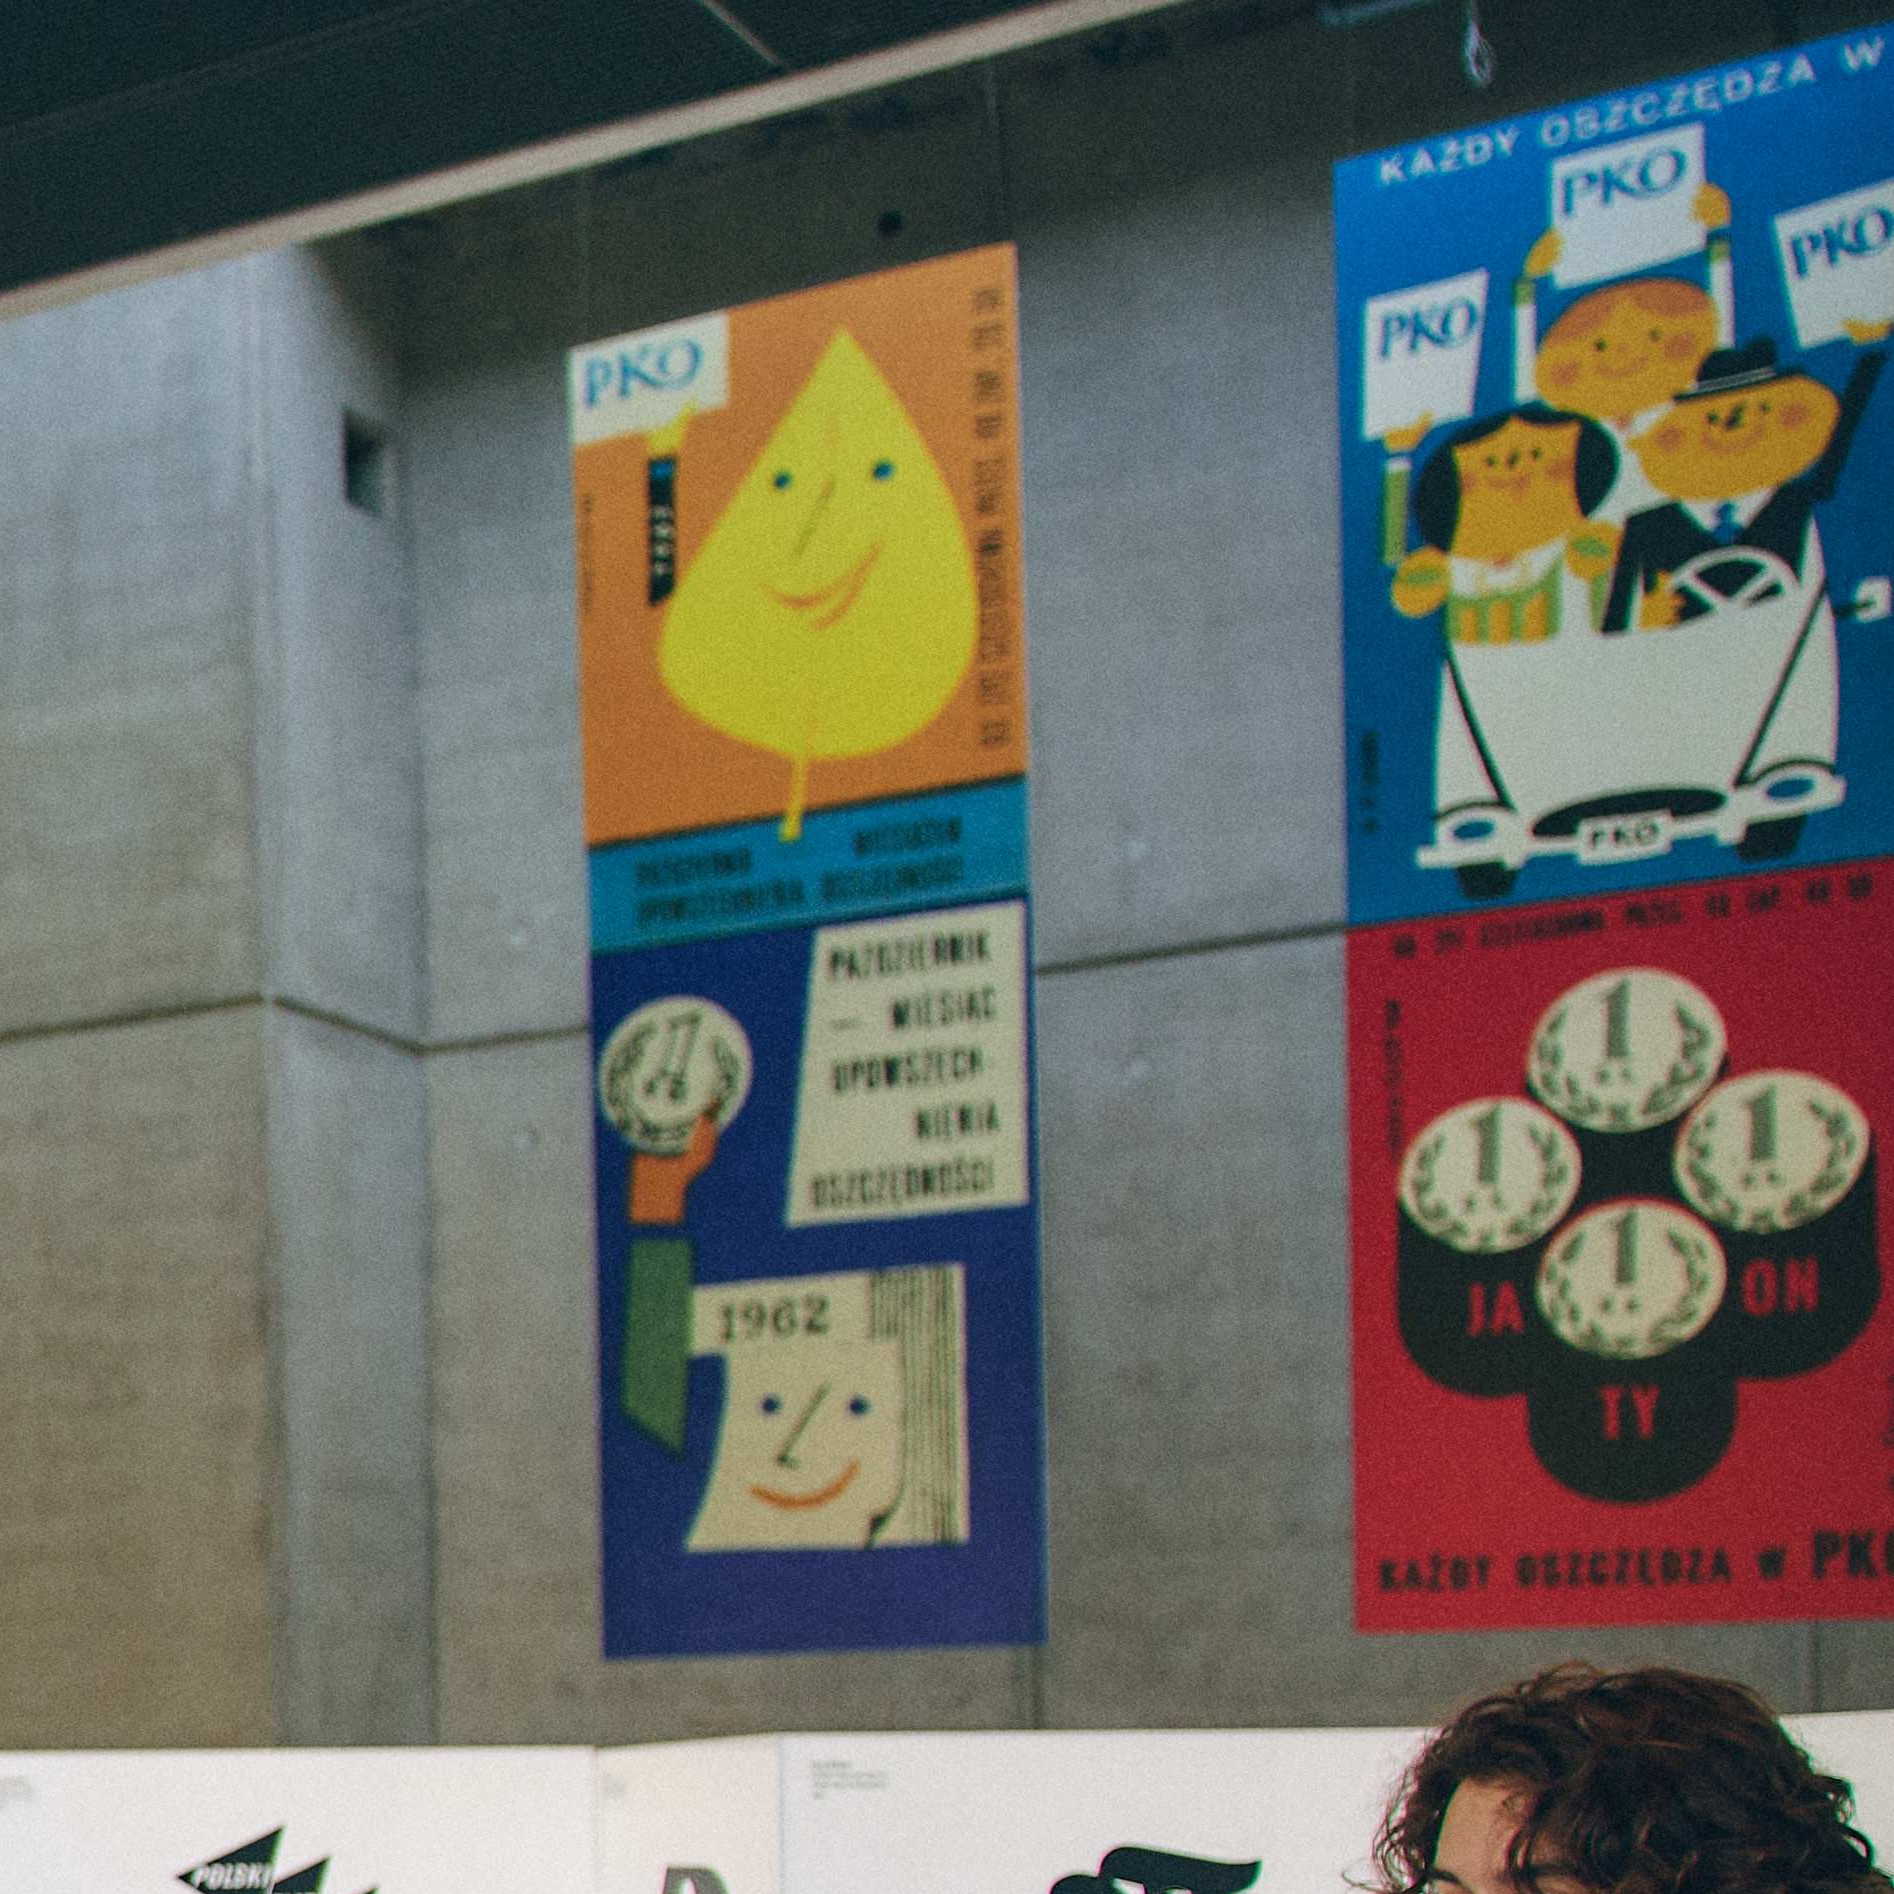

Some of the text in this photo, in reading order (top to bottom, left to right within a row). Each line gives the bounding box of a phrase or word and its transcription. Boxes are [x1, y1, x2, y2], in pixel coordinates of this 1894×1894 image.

[1377, 127, 1520, 187] KAŻDY
[1840, 35, 1886, 73] W
[1559, 147, 1688, 220] PKO
[1790, 205, 1894, 282] PKO
[1380, 298, 1478, 360] PKO
[583, 337, 705, 408] PKO
[1590, 818, 1662, 850] PKO
[1467, 1281, 1525, 1338] JA
[1741, 1257, 1820, 1317] ON
[719, 1294, 830, 1342] 1962
[1598, 1384, 1659, 1439] TY
[194, 1861, 274, 1890] POLSKI
